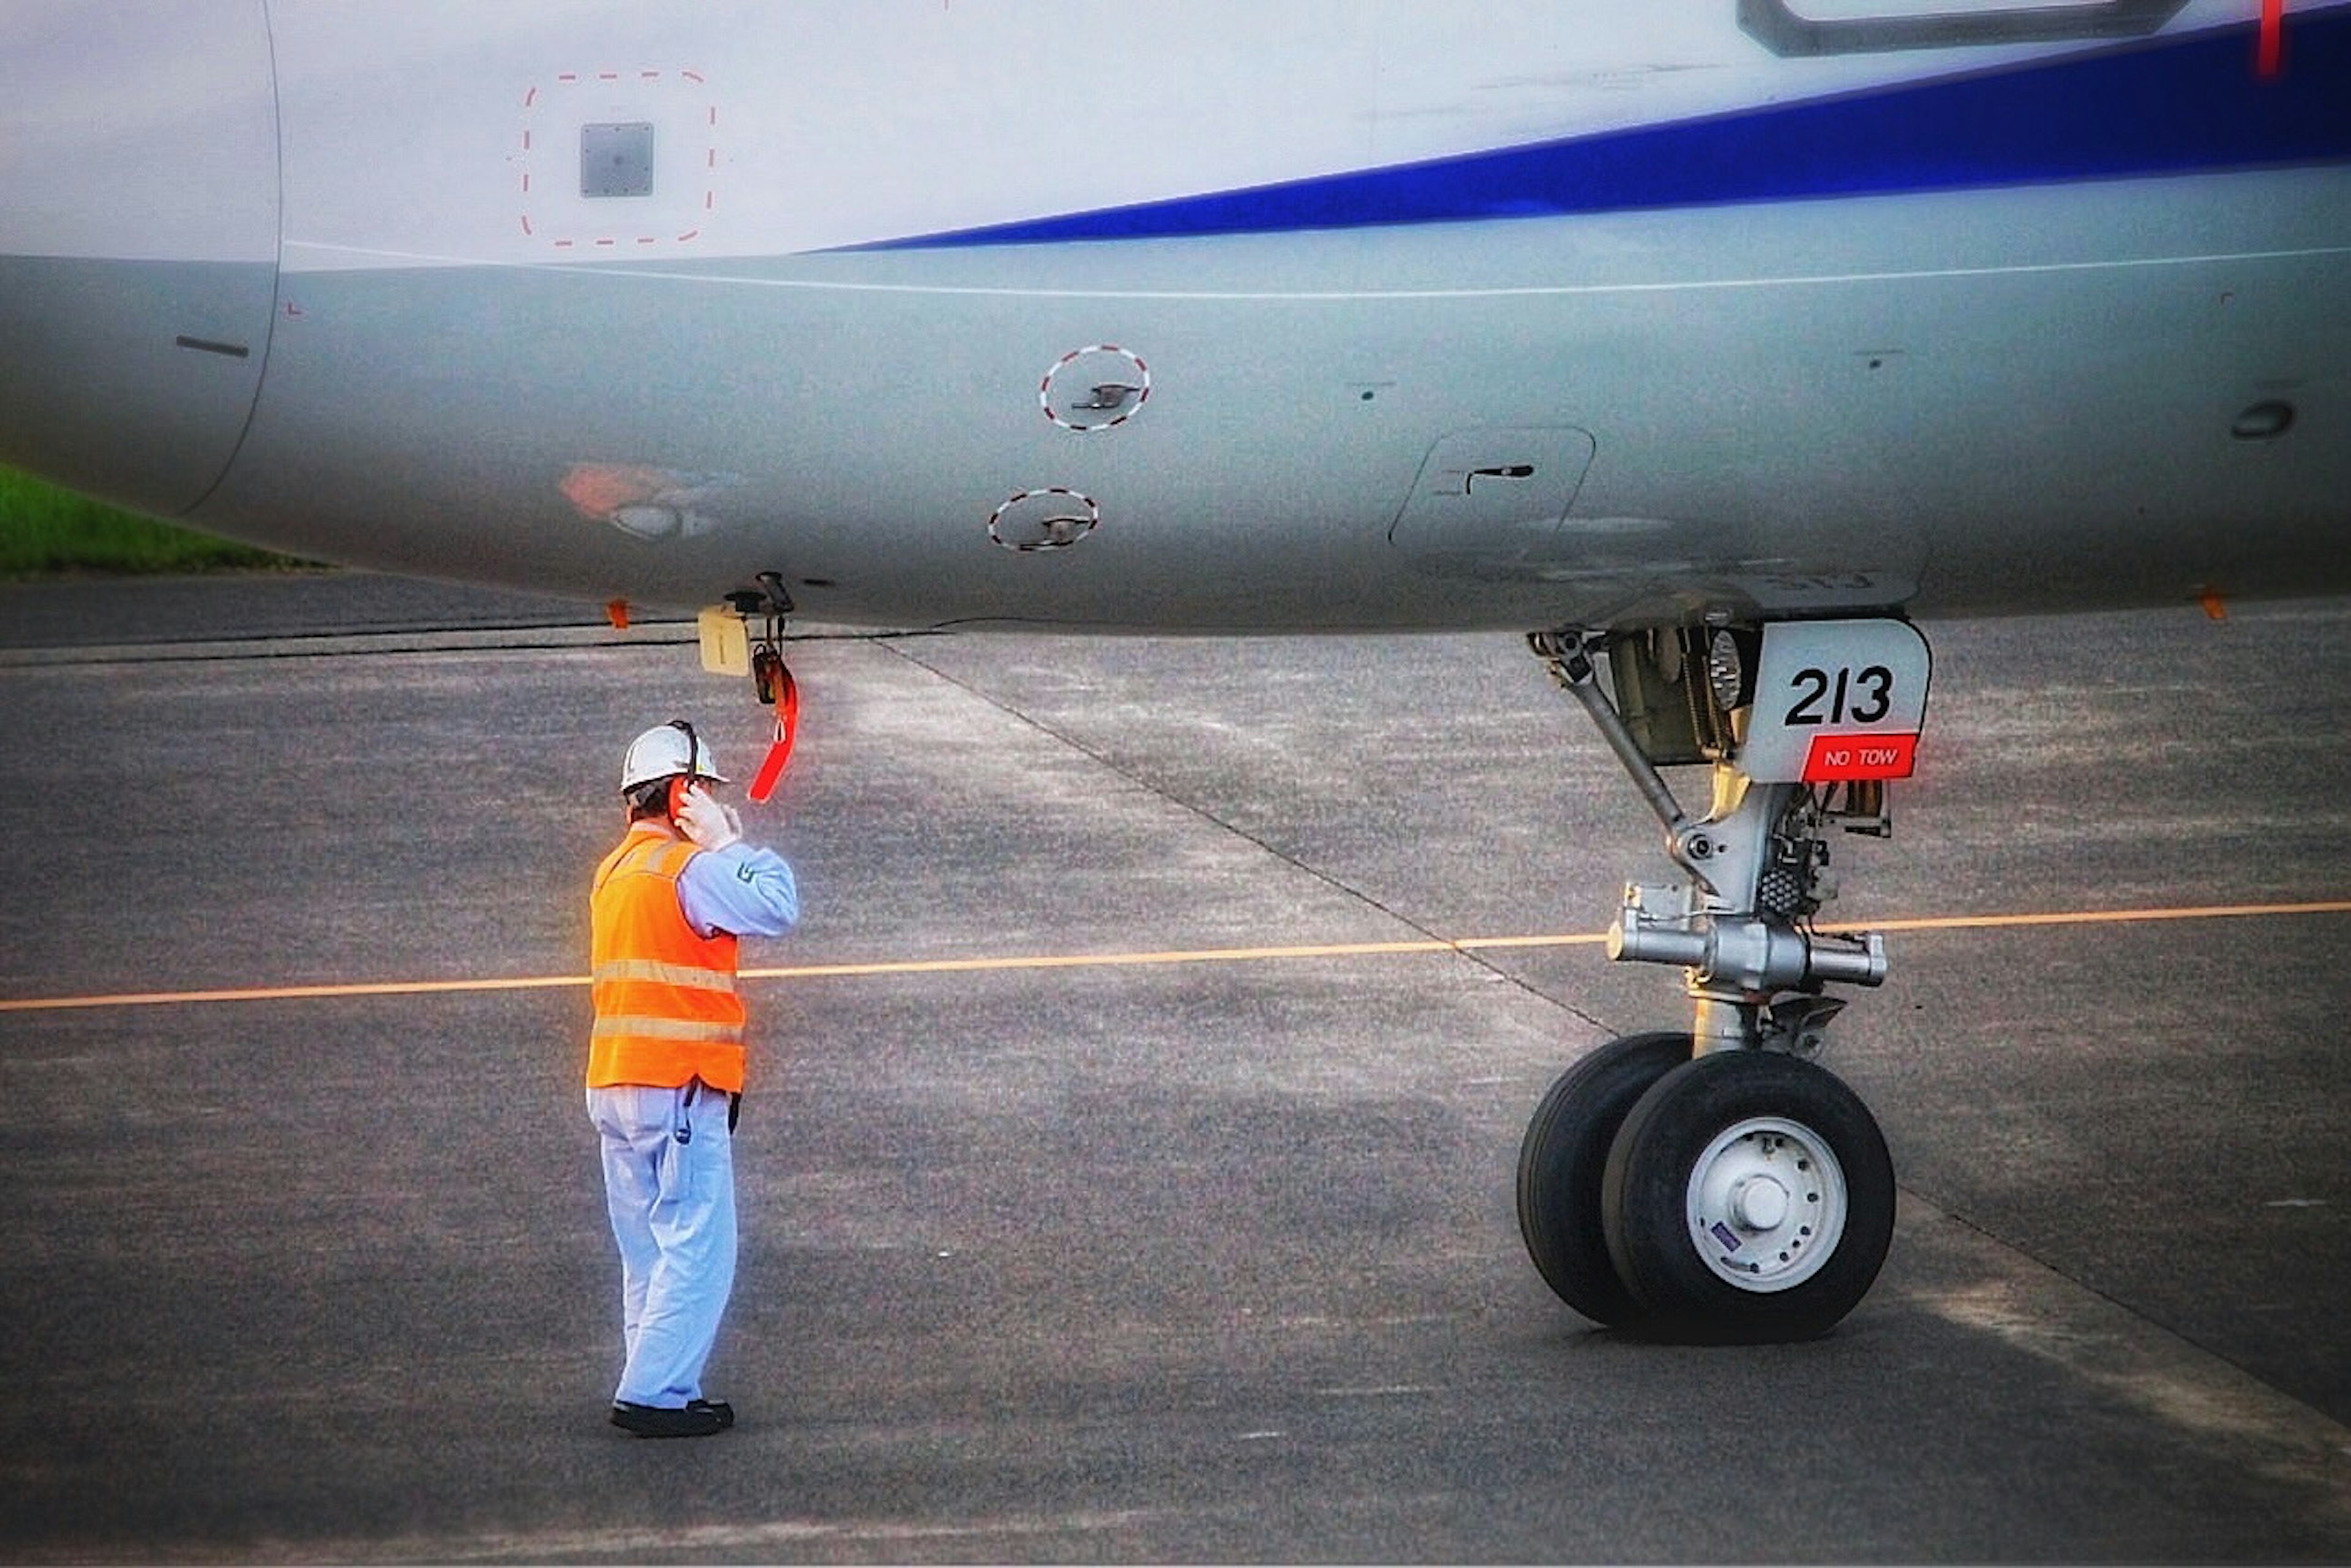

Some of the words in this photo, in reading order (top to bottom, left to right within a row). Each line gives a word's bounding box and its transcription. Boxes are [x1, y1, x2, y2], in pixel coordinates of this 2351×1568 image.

[1785, 666, 1893, 726] 213
[1824, 751, 1850, 766] NO
[1858, 749, 1898, 765] TOW
